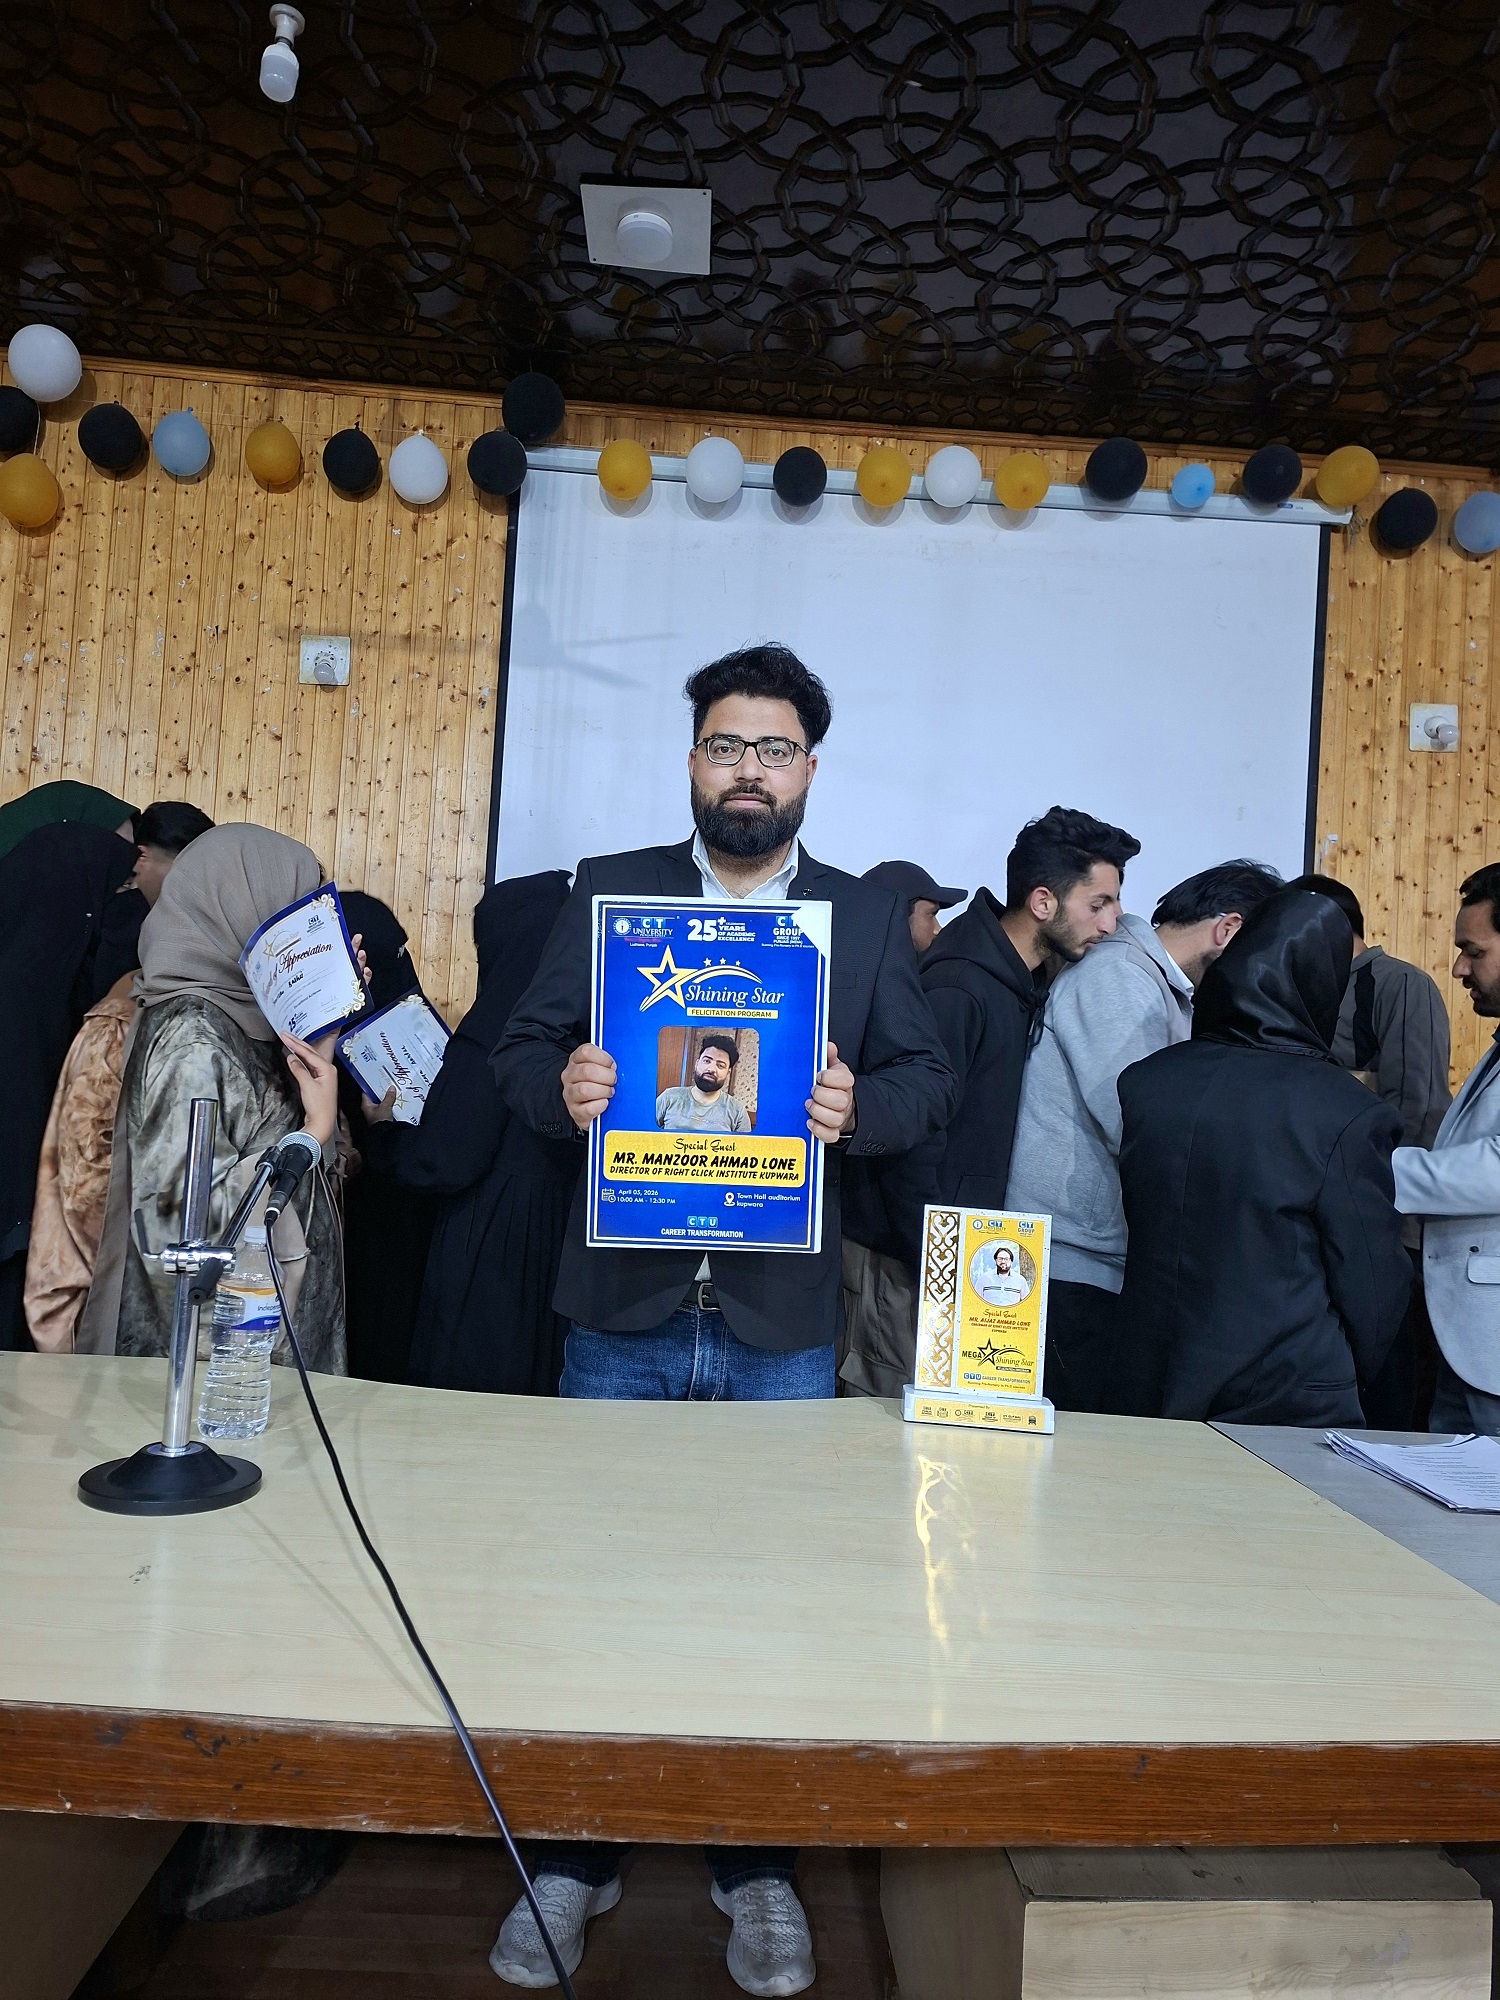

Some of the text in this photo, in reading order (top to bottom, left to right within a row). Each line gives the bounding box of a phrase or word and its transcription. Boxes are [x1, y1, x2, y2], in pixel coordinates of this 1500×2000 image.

[632, 928, 674, 936] UNIVERSITY
[279, 944, 333, 973] Appreciation
[685, 985, 785, 1008] Shining Star
[691, 1009, 736, 1017] FELICITATION
[380, 1031, 413, 1086] Appreciation
[673, 1138, 738, 1153] Special Guest
[613, 1152, 796, 1170] MR. MANZOOR AHMAD LONE
[610, 1166, 799, 1181] DIRECTOR OF RIGHT CLICK INSTITUTE KUPWARA
[687, 1229, 743, 1238] TRANSFORMATION
[996, 1356, 1034, 1367] Shining Star
